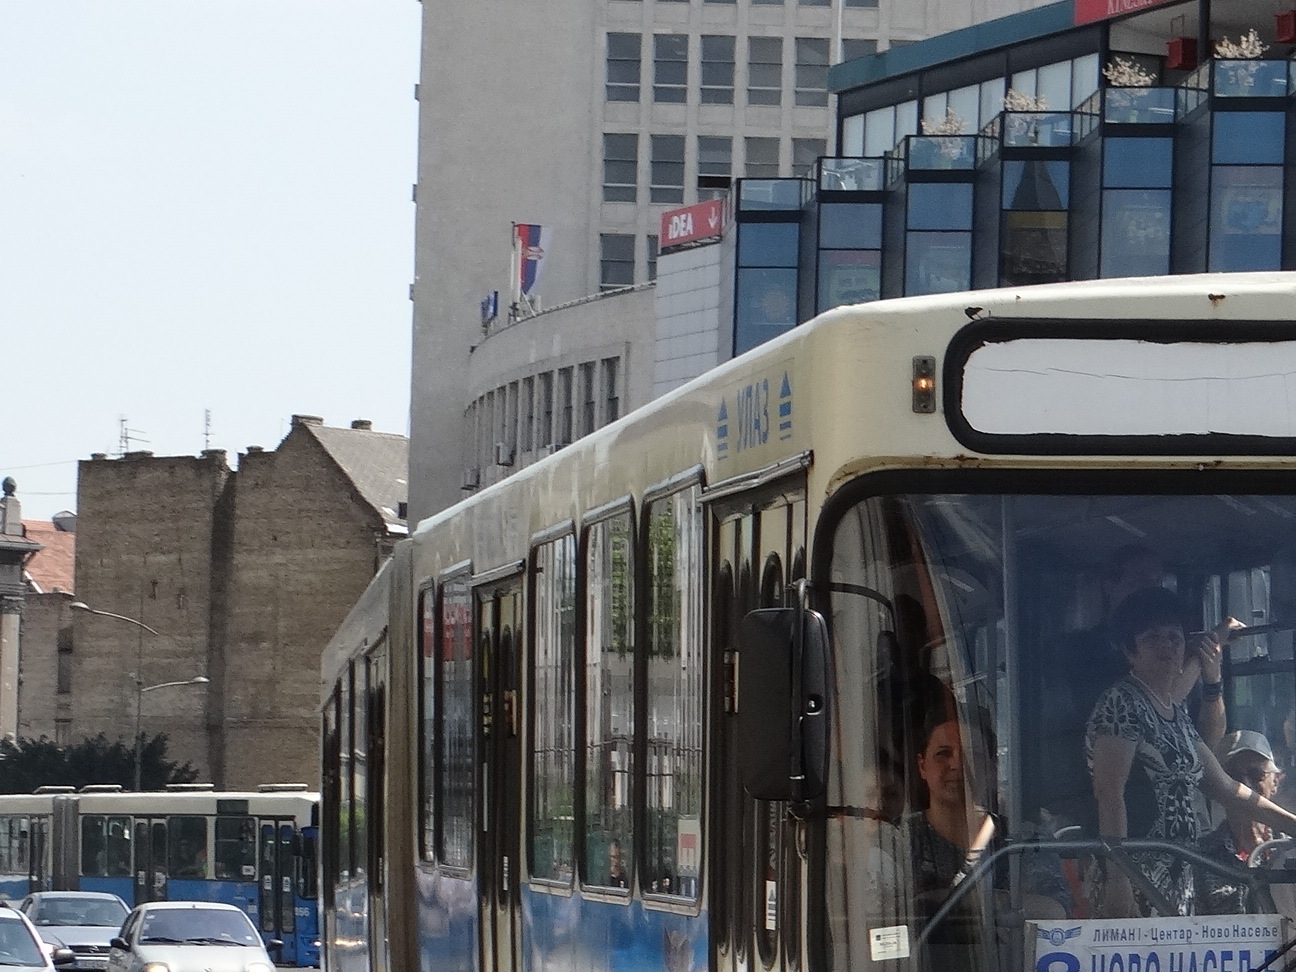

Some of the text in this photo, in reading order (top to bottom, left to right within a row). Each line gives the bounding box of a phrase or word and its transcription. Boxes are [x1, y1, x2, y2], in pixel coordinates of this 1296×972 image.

[736, 377, 770, 454] УЛАЗ
[1150, 926, 1193, 943] Центар
[1201, 925, 1231, 939] Ново
[1232, 924, 1278, 938] Насеље
